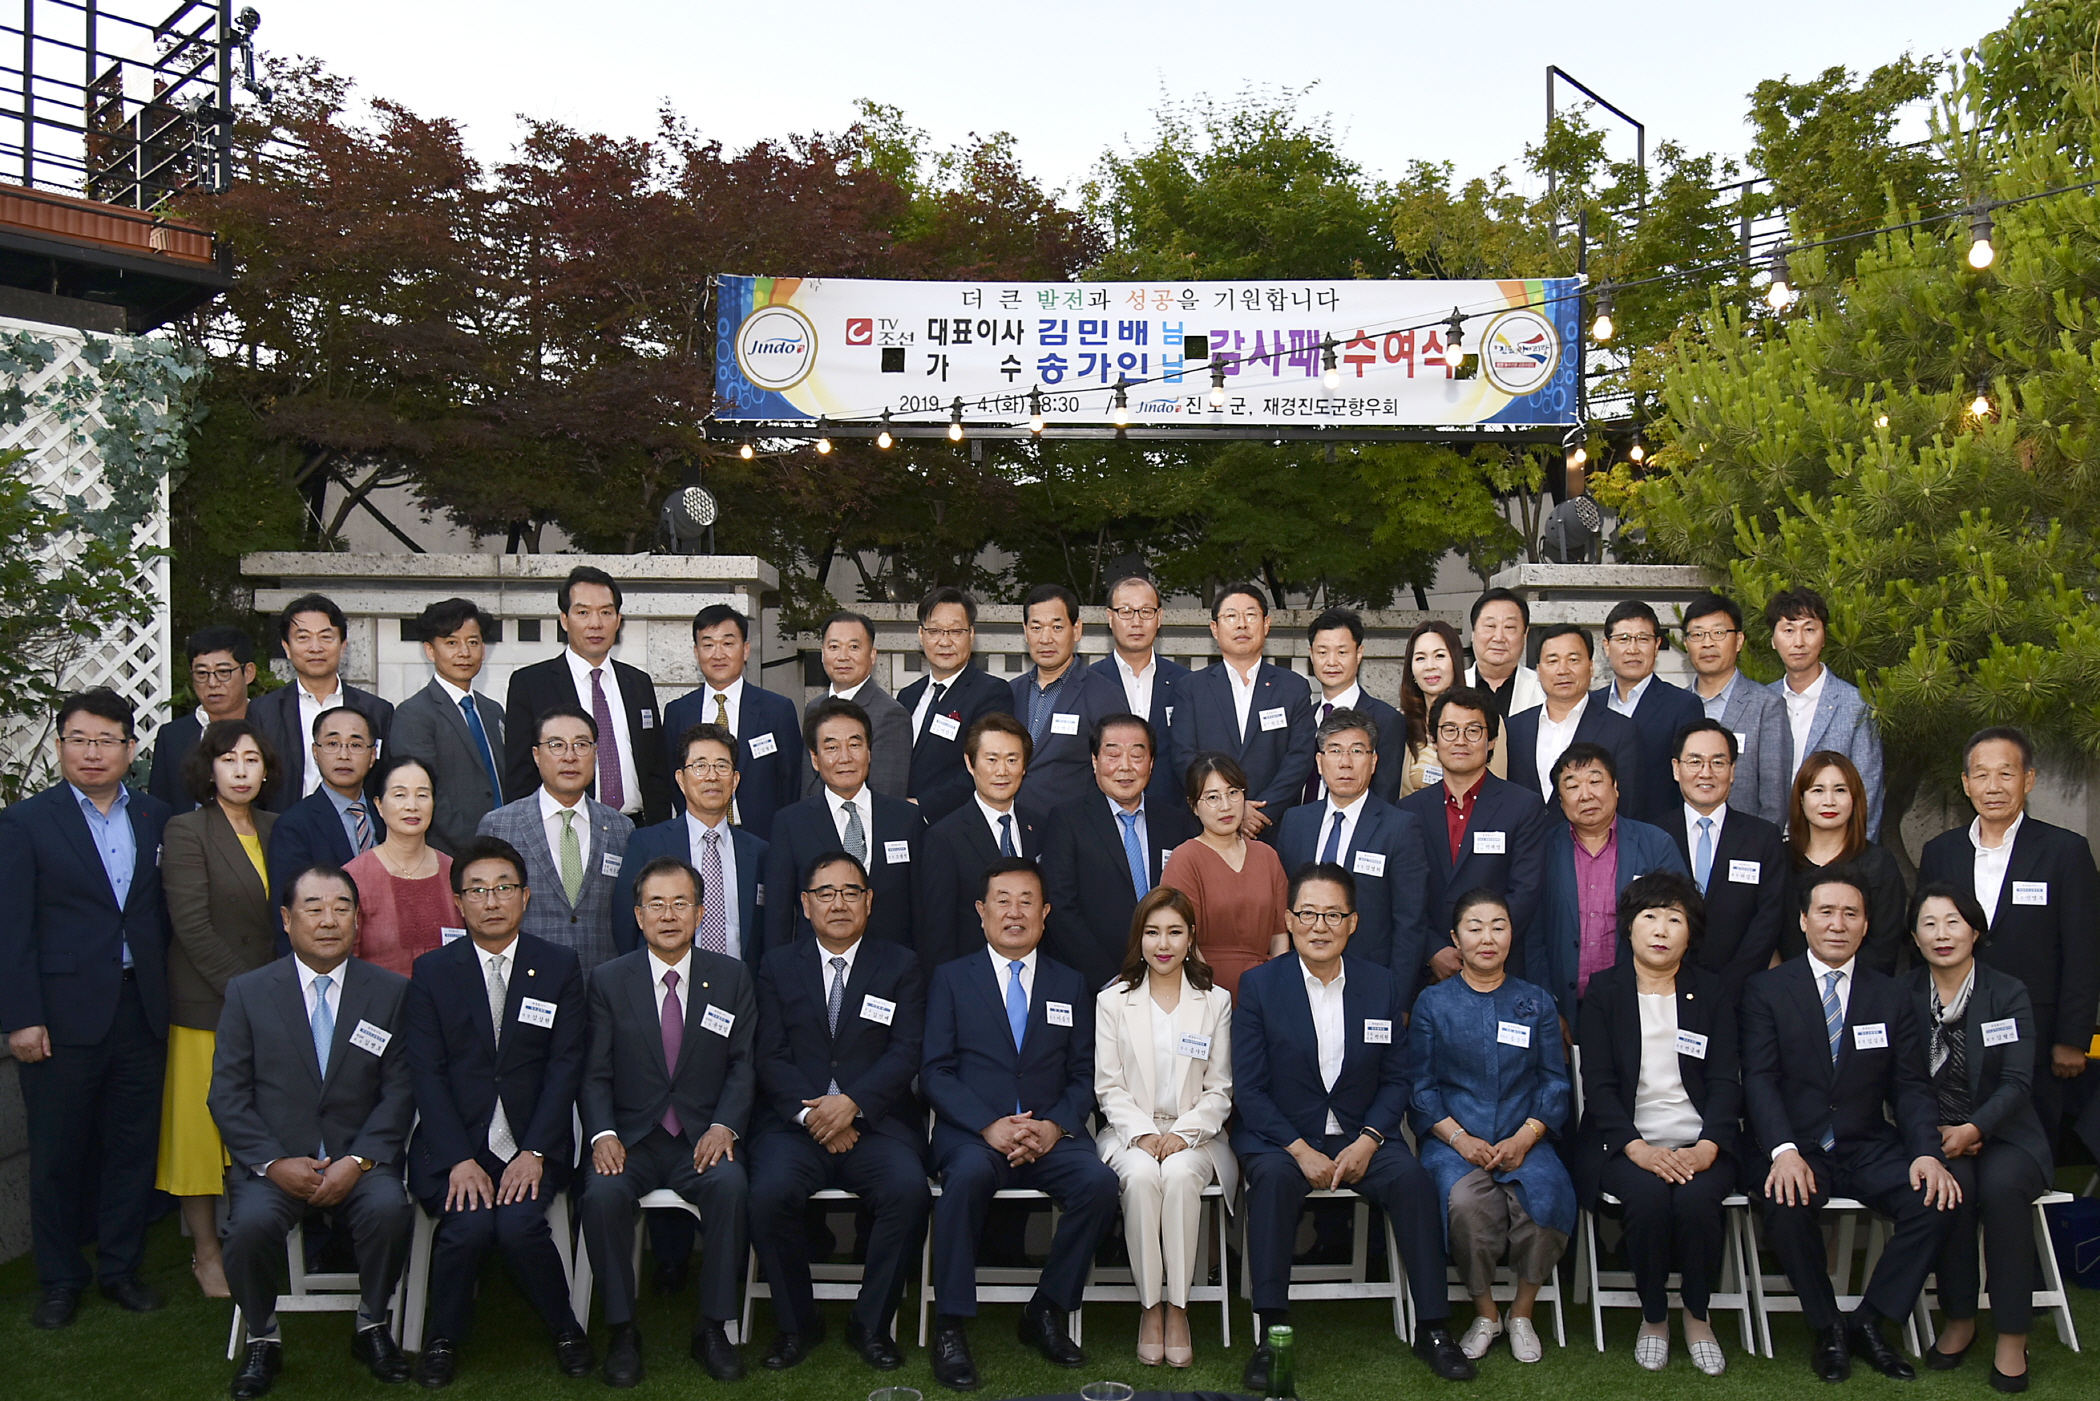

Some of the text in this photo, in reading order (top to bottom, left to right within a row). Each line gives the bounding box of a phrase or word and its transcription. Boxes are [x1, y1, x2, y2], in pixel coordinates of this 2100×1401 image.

[961, 288, 1340, 311] 더 큰 발전과 성공을 기원합니다
[877, 318, 900, 330] TV
[927, 318, 1184, 346] 대표이사 김민배 님
[747, 340, 796, 356] Jindo
[876, 331, 915, 347] 조선
[1210, 329, 1320, 377] 감사패
[1036, 353, 1149, 383] 송가인
[1162, 353, 1184, 383] 님
[899, 395, 944, 412] 2019.
[1135, 400, 1175, 415] Jindo
[1262, 396, 1399, 416] 재경진도군향우회
